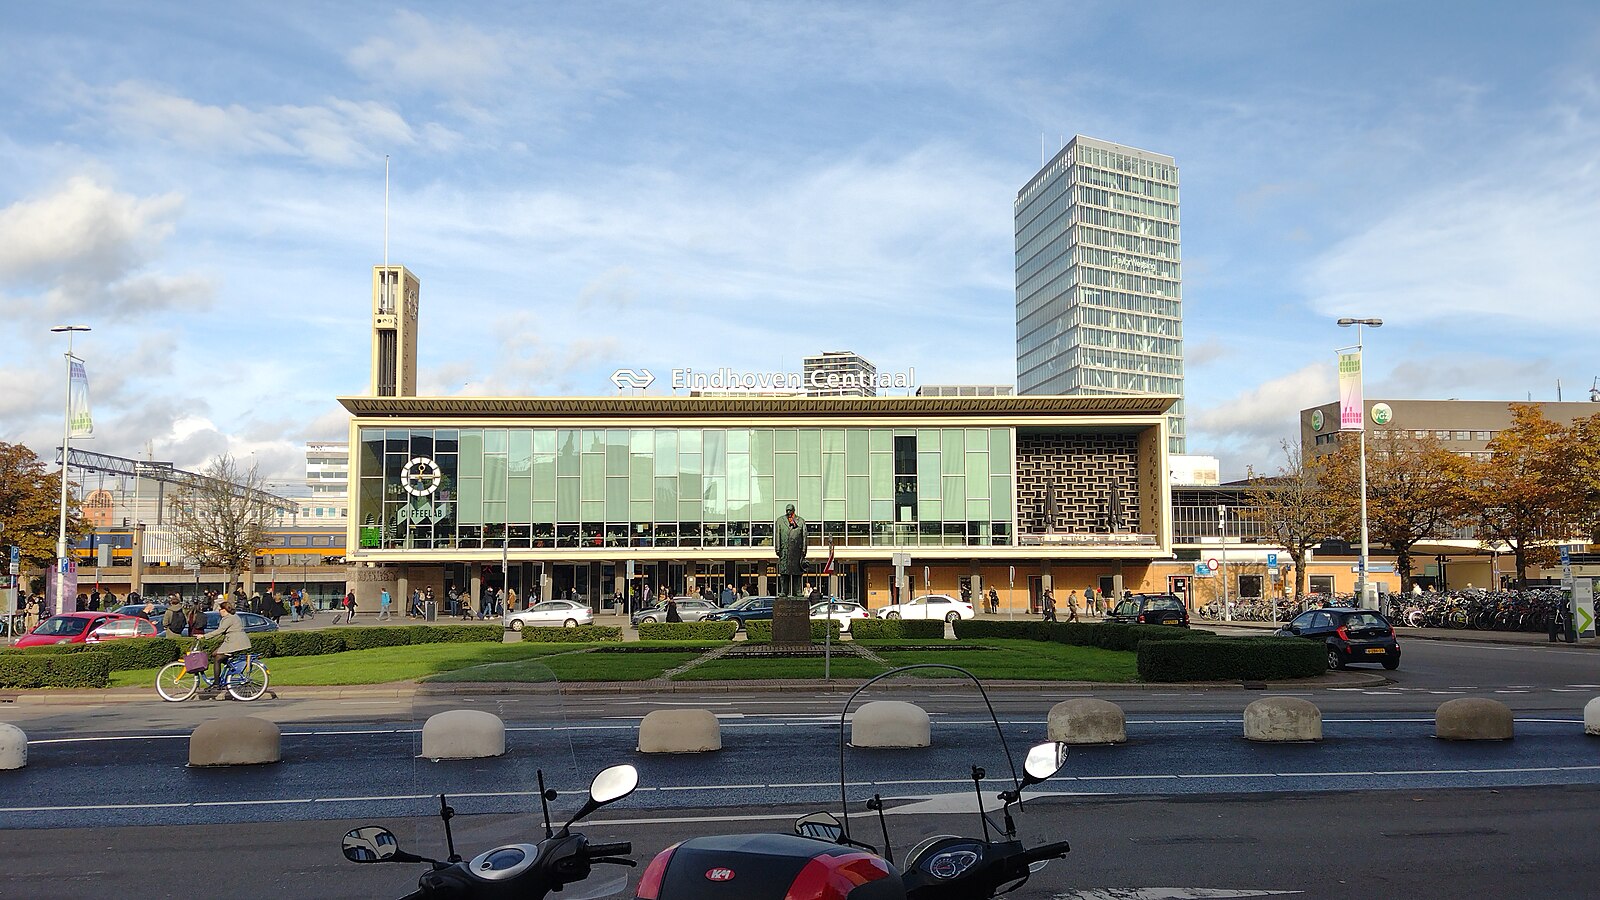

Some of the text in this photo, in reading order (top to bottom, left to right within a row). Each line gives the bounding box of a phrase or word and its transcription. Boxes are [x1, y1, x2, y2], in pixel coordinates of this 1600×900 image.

[671, 367, 916, 389] Eindhoven Centraal
[401, 509, 443, 518] CFFEELAB
